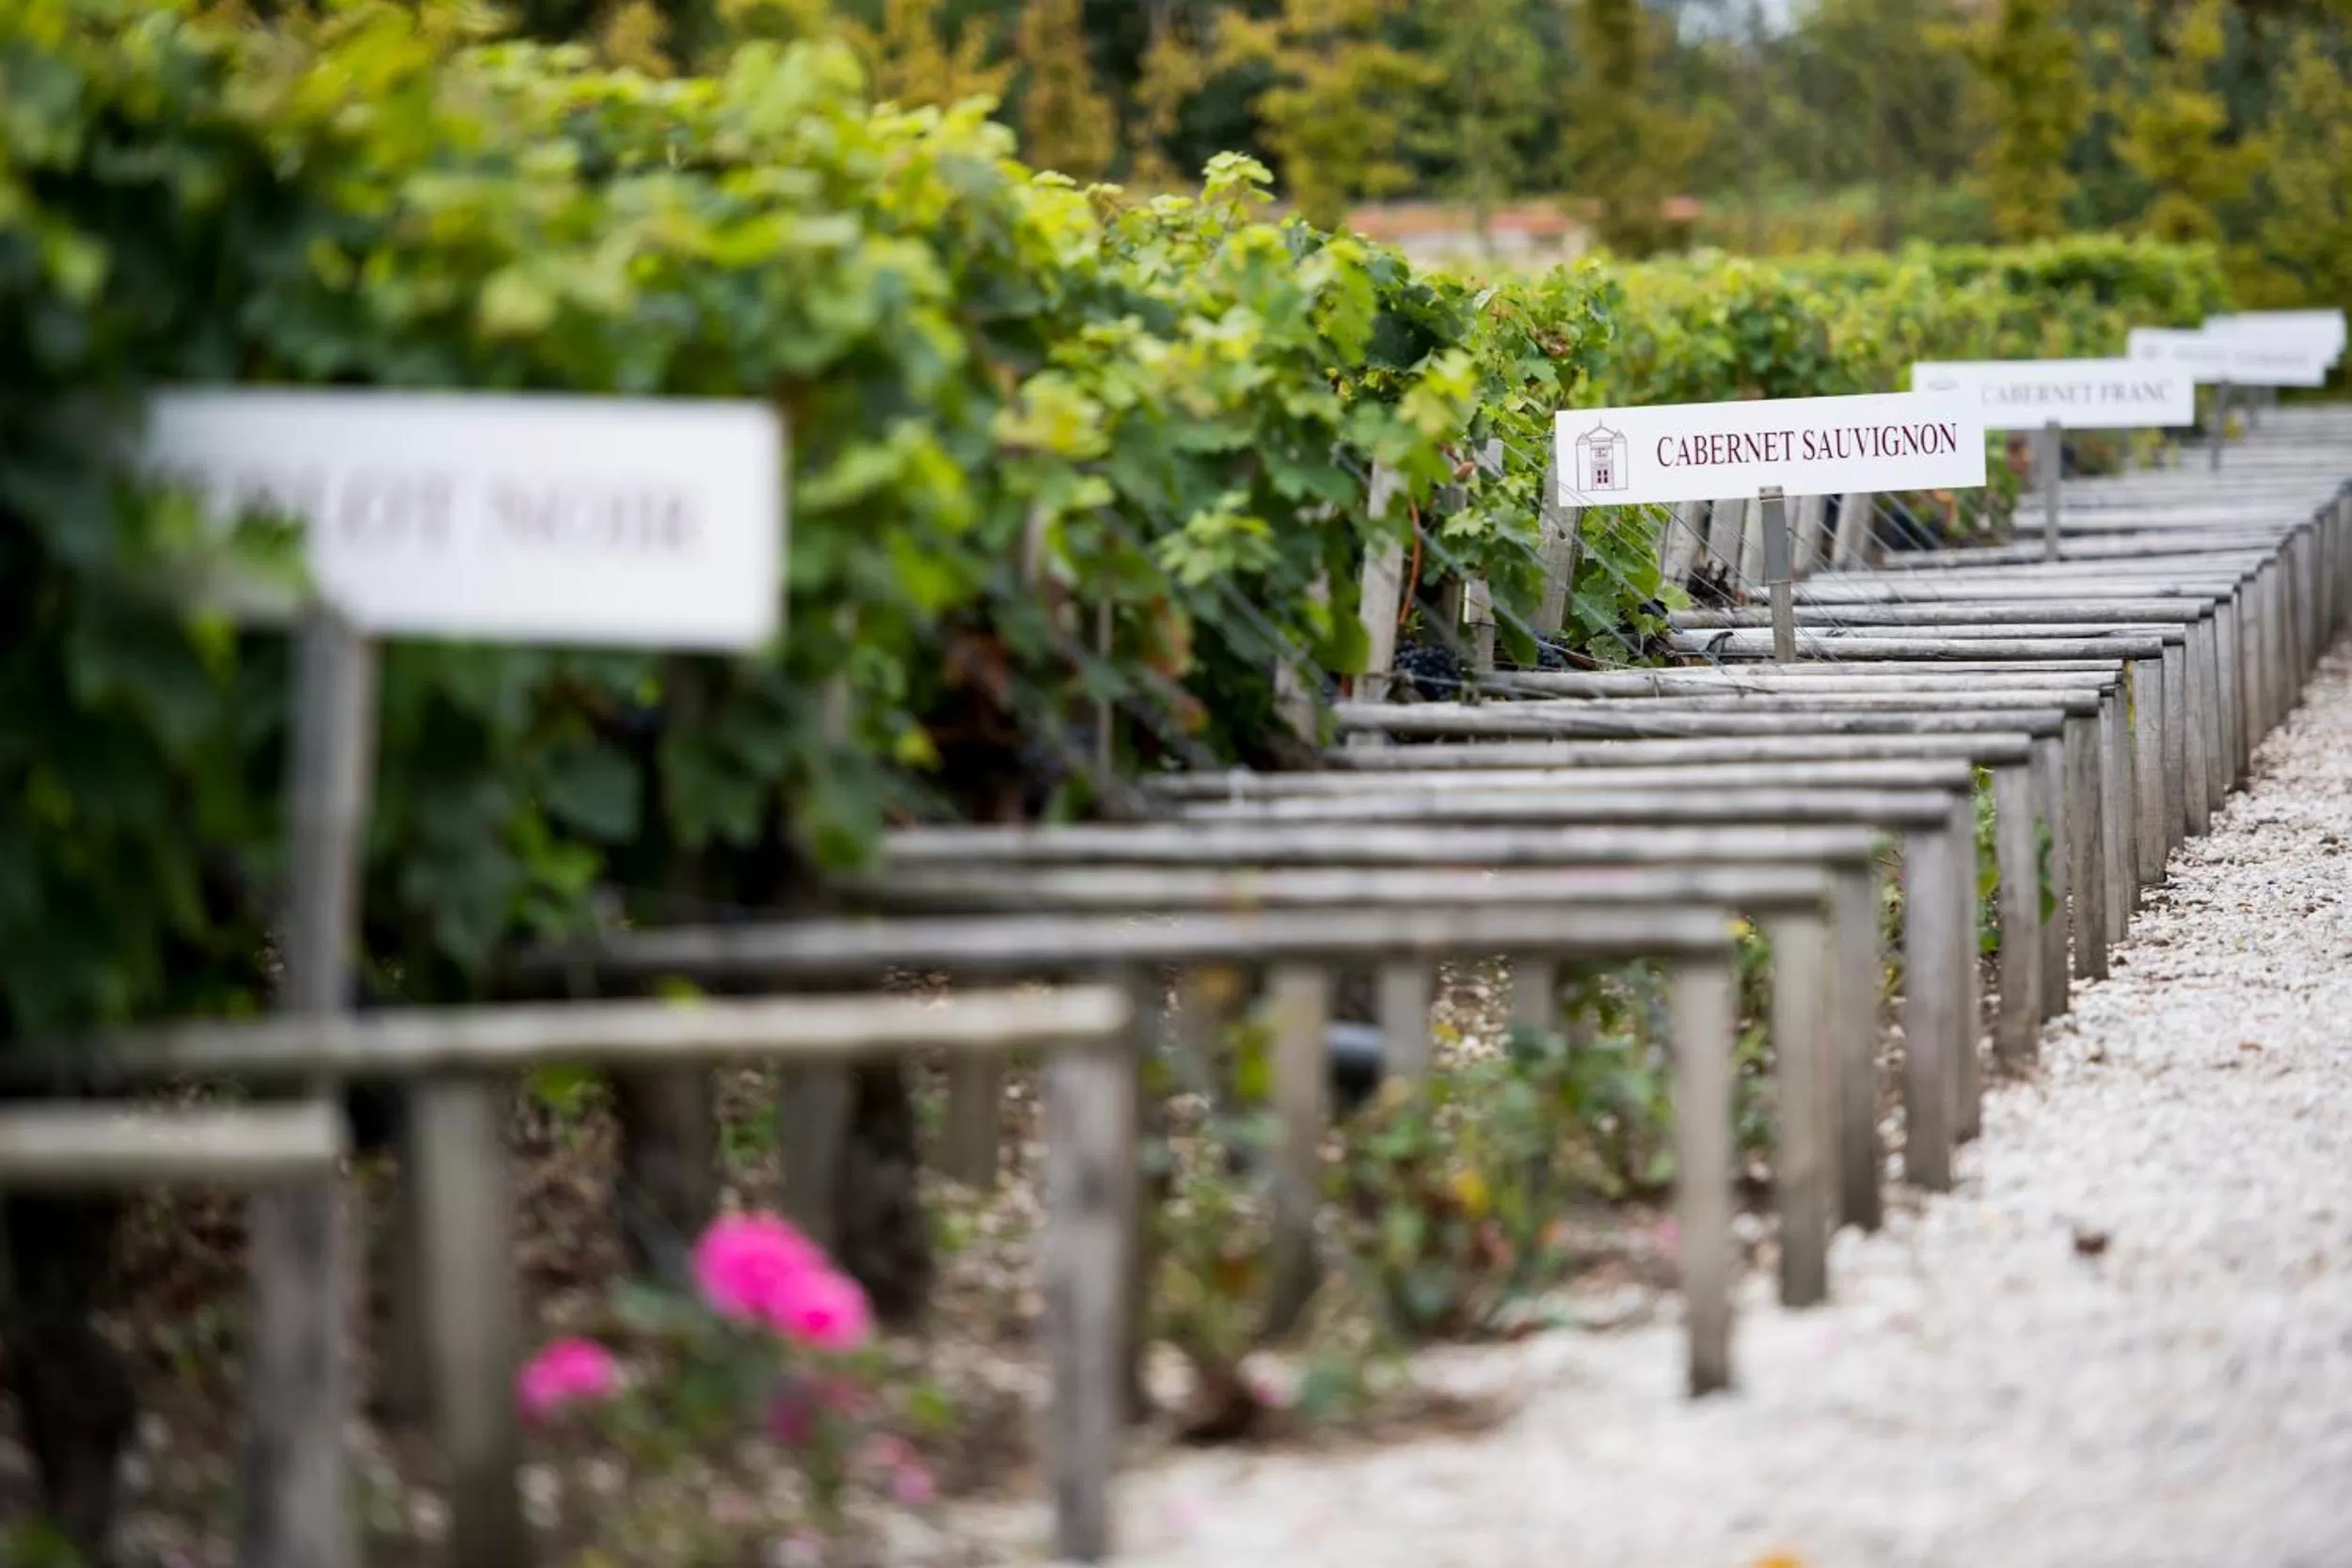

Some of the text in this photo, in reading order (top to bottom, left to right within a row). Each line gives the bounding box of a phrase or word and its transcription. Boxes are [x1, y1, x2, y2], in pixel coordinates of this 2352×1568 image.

[2098, 376, 2175, 404] FRANC
[1656, 422, 1958, 467] CABERNET SAUVIGNON
